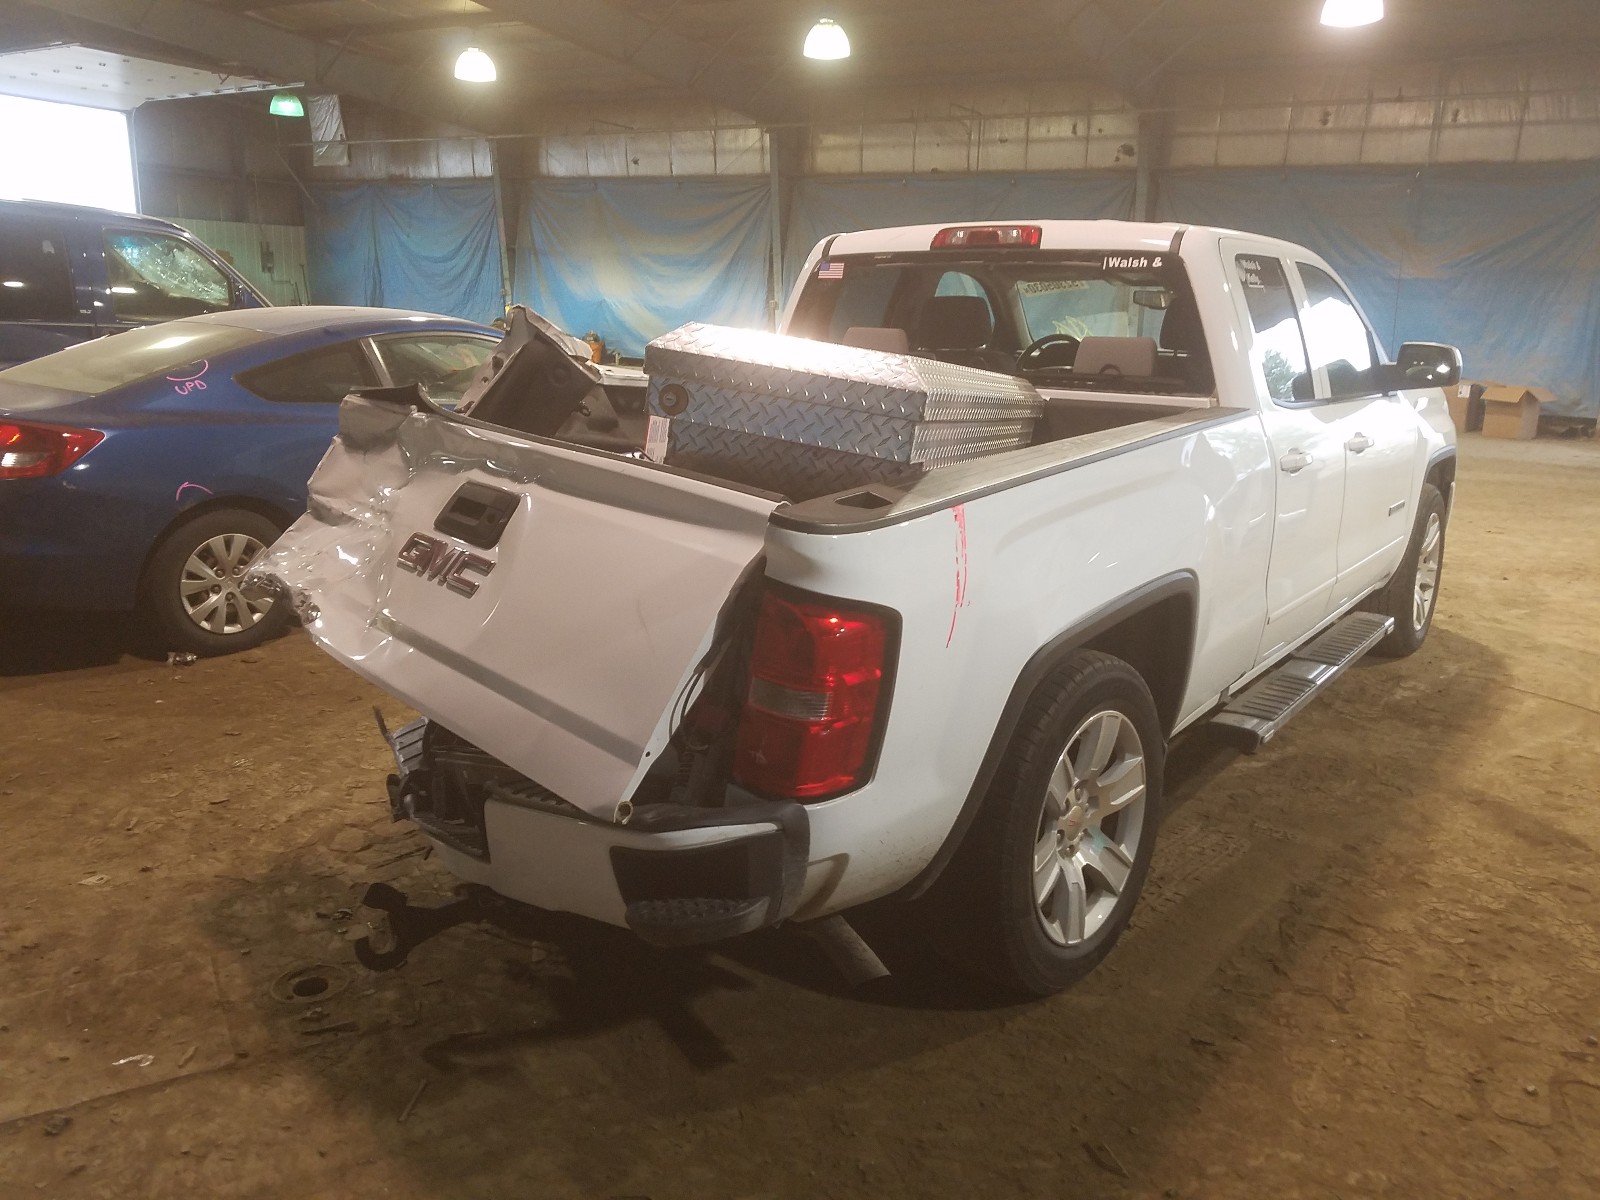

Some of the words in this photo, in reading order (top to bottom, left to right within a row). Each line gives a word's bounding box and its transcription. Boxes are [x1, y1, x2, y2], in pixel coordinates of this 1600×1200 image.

[1152, 257, 1163, 267] &
[174, 380, 207, 395] UPD
[397, 532, 496, 599] GMC
